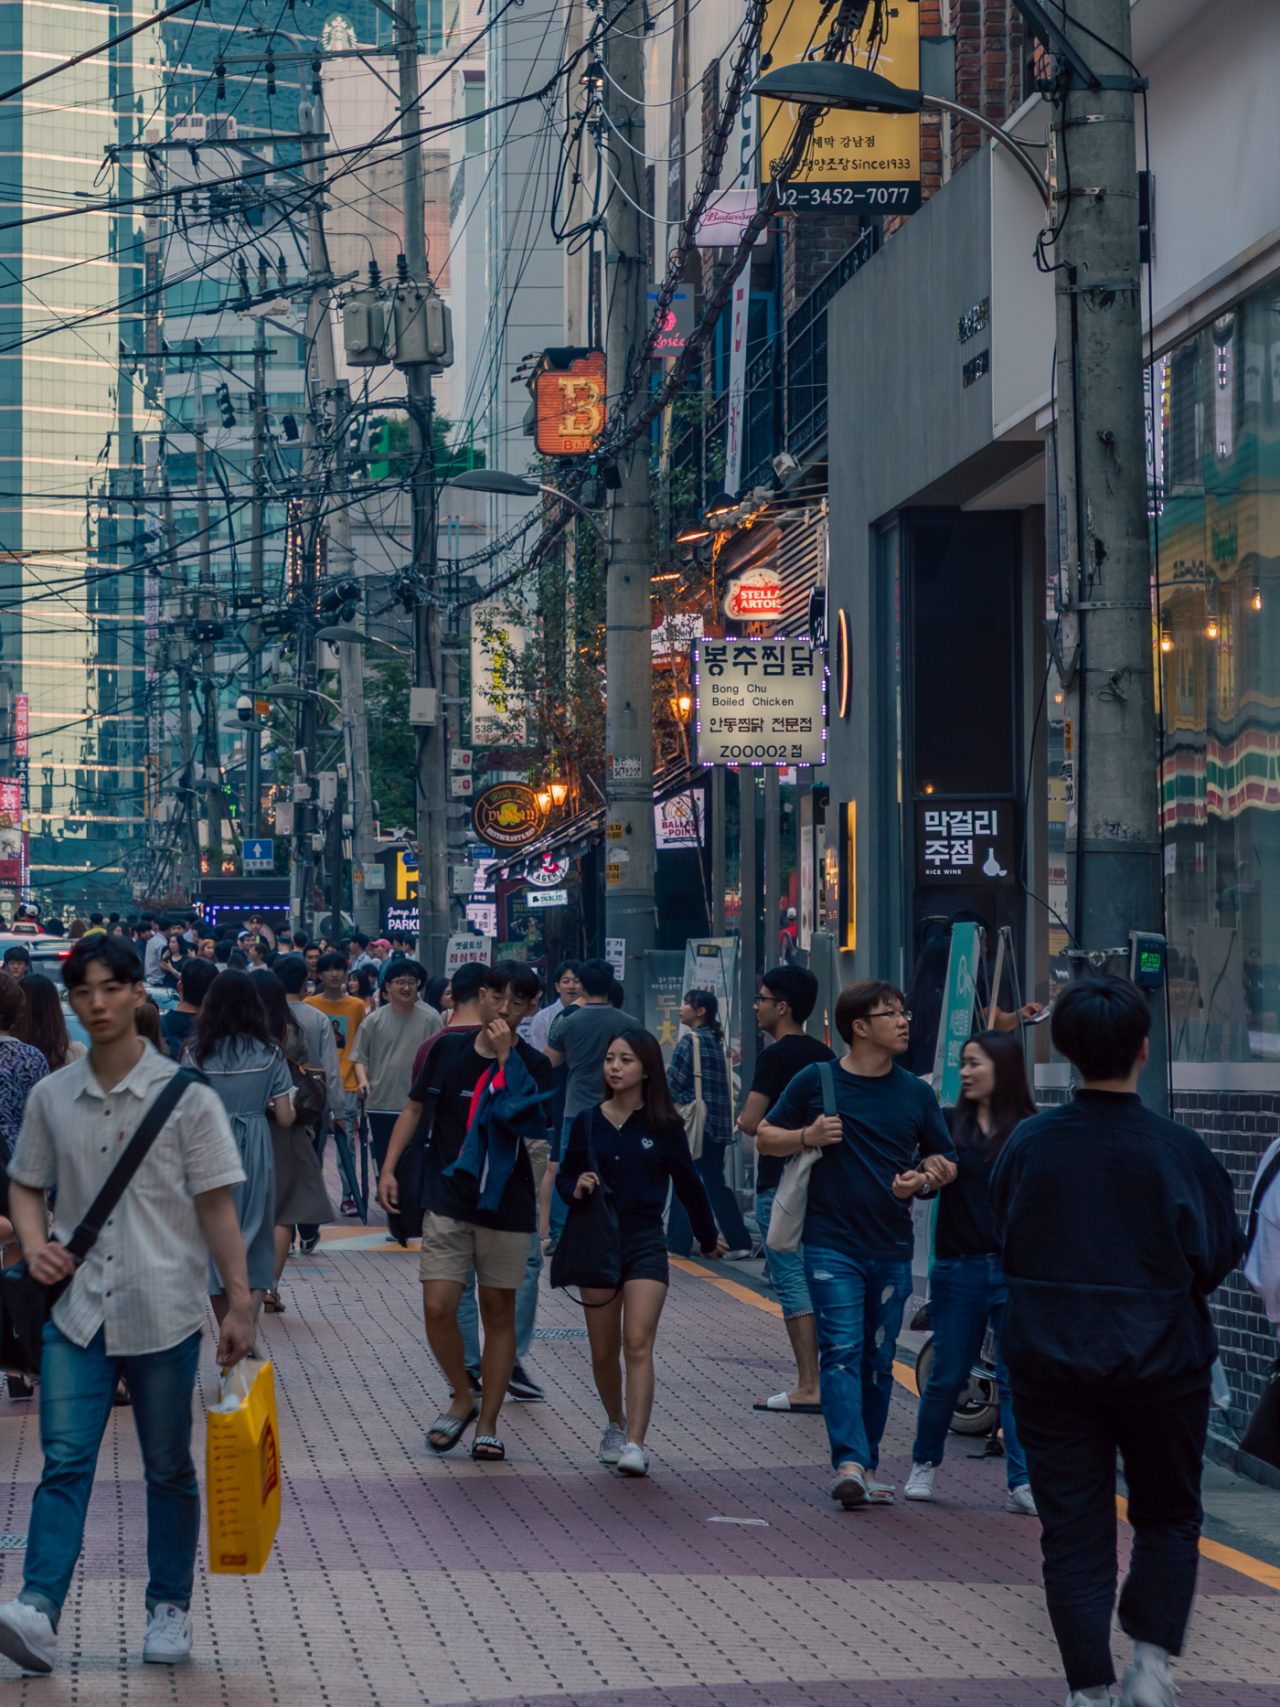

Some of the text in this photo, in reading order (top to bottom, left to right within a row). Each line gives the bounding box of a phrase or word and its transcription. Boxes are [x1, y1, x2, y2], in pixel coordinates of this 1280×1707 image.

[840, 136, 875, 148] 강남점
[704, 645, 814, 677] 봉추찜닭
[712, 683, 767, 694] Bong Chu
[712, 697, 794, 707] Boiled Chicken
[709, 717, 813, 733] 안동찜닭 전문점
[790, 744, 803, 758] 점
[925, 810, 998, 837] 막걸리
[925, 840, 974, 866] 주점
